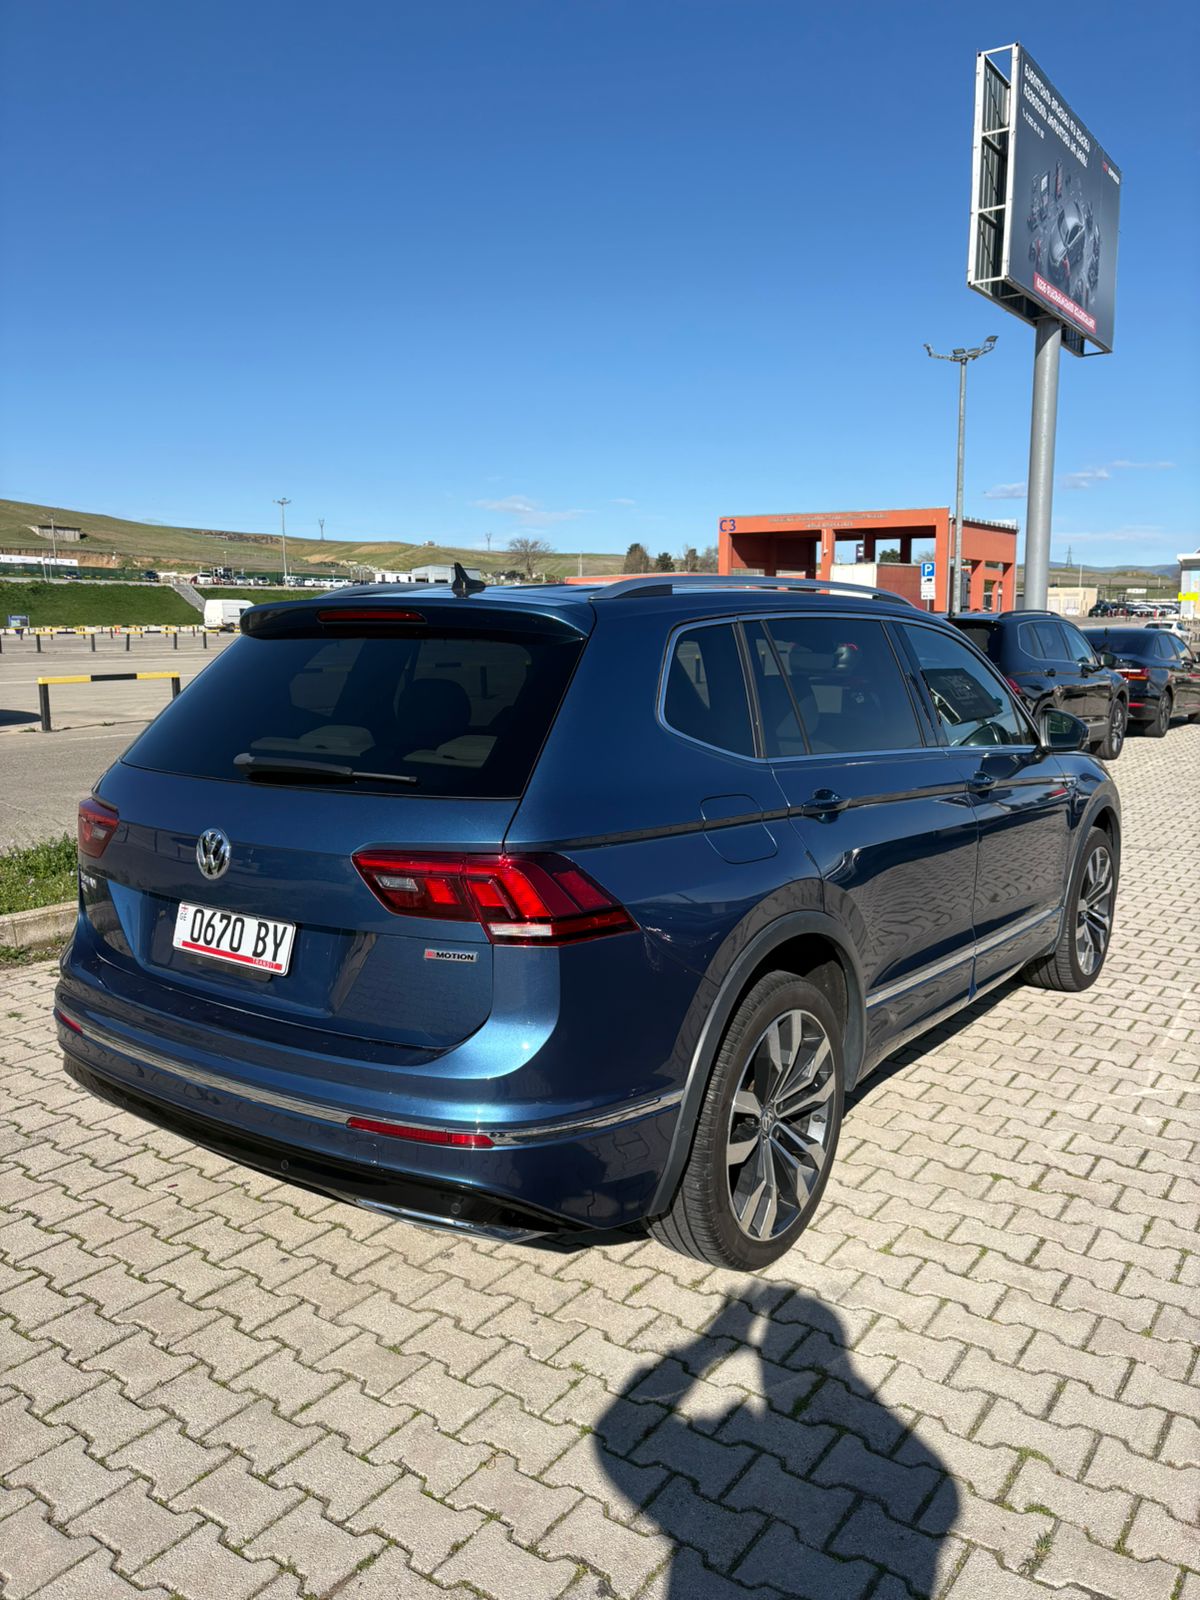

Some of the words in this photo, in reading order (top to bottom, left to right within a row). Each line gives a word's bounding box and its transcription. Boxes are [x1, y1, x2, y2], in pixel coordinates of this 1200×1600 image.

[719, 519, 736, 532] C3
[924, 564, 933, 576] P
[190, 908, 245, 953] 0670
[252, 921, 288, 962] BY
